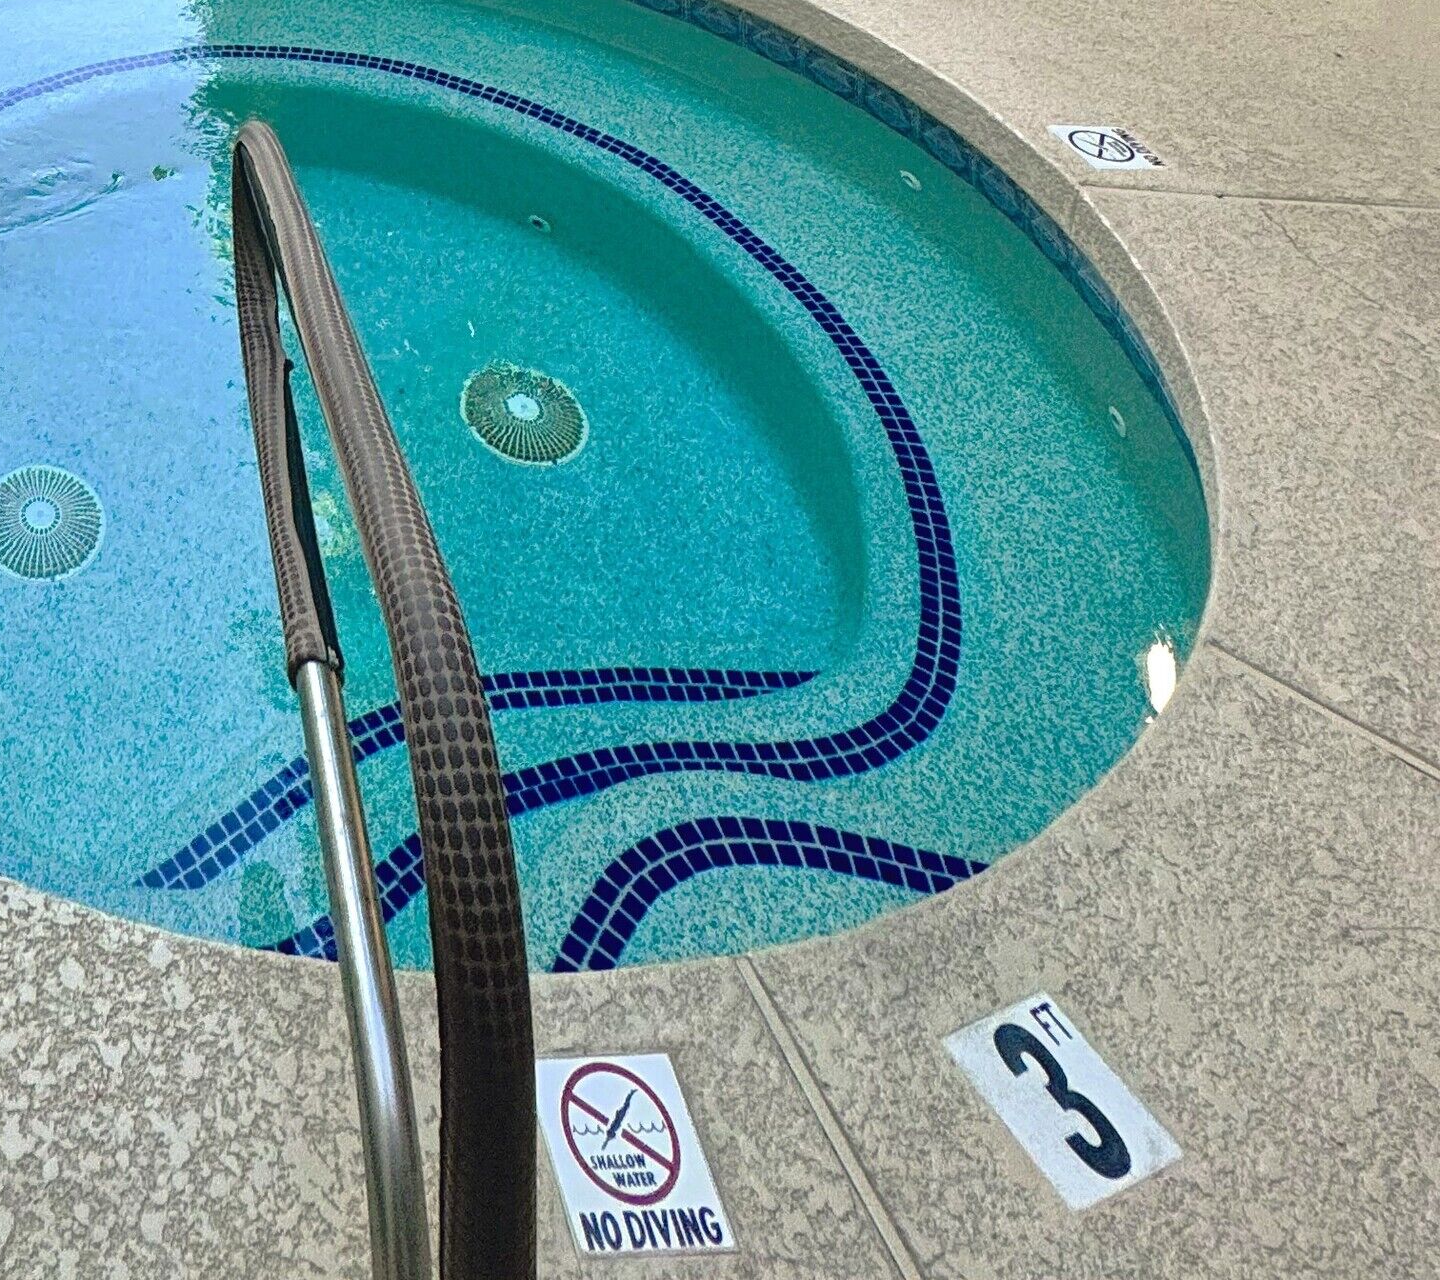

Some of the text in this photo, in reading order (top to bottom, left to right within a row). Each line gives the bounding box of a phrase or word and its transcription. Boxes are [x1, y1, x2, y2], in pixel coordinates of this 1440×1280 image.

[1029, 1002, 1073, 1046] FT
[993, 1023, 1131, 1179] 3
[590, 1154, 645, 1170] SHALLOW
[612, 1171, 657, 1188] WATER
[579, 1206, 723, 1251] NO DIVING
